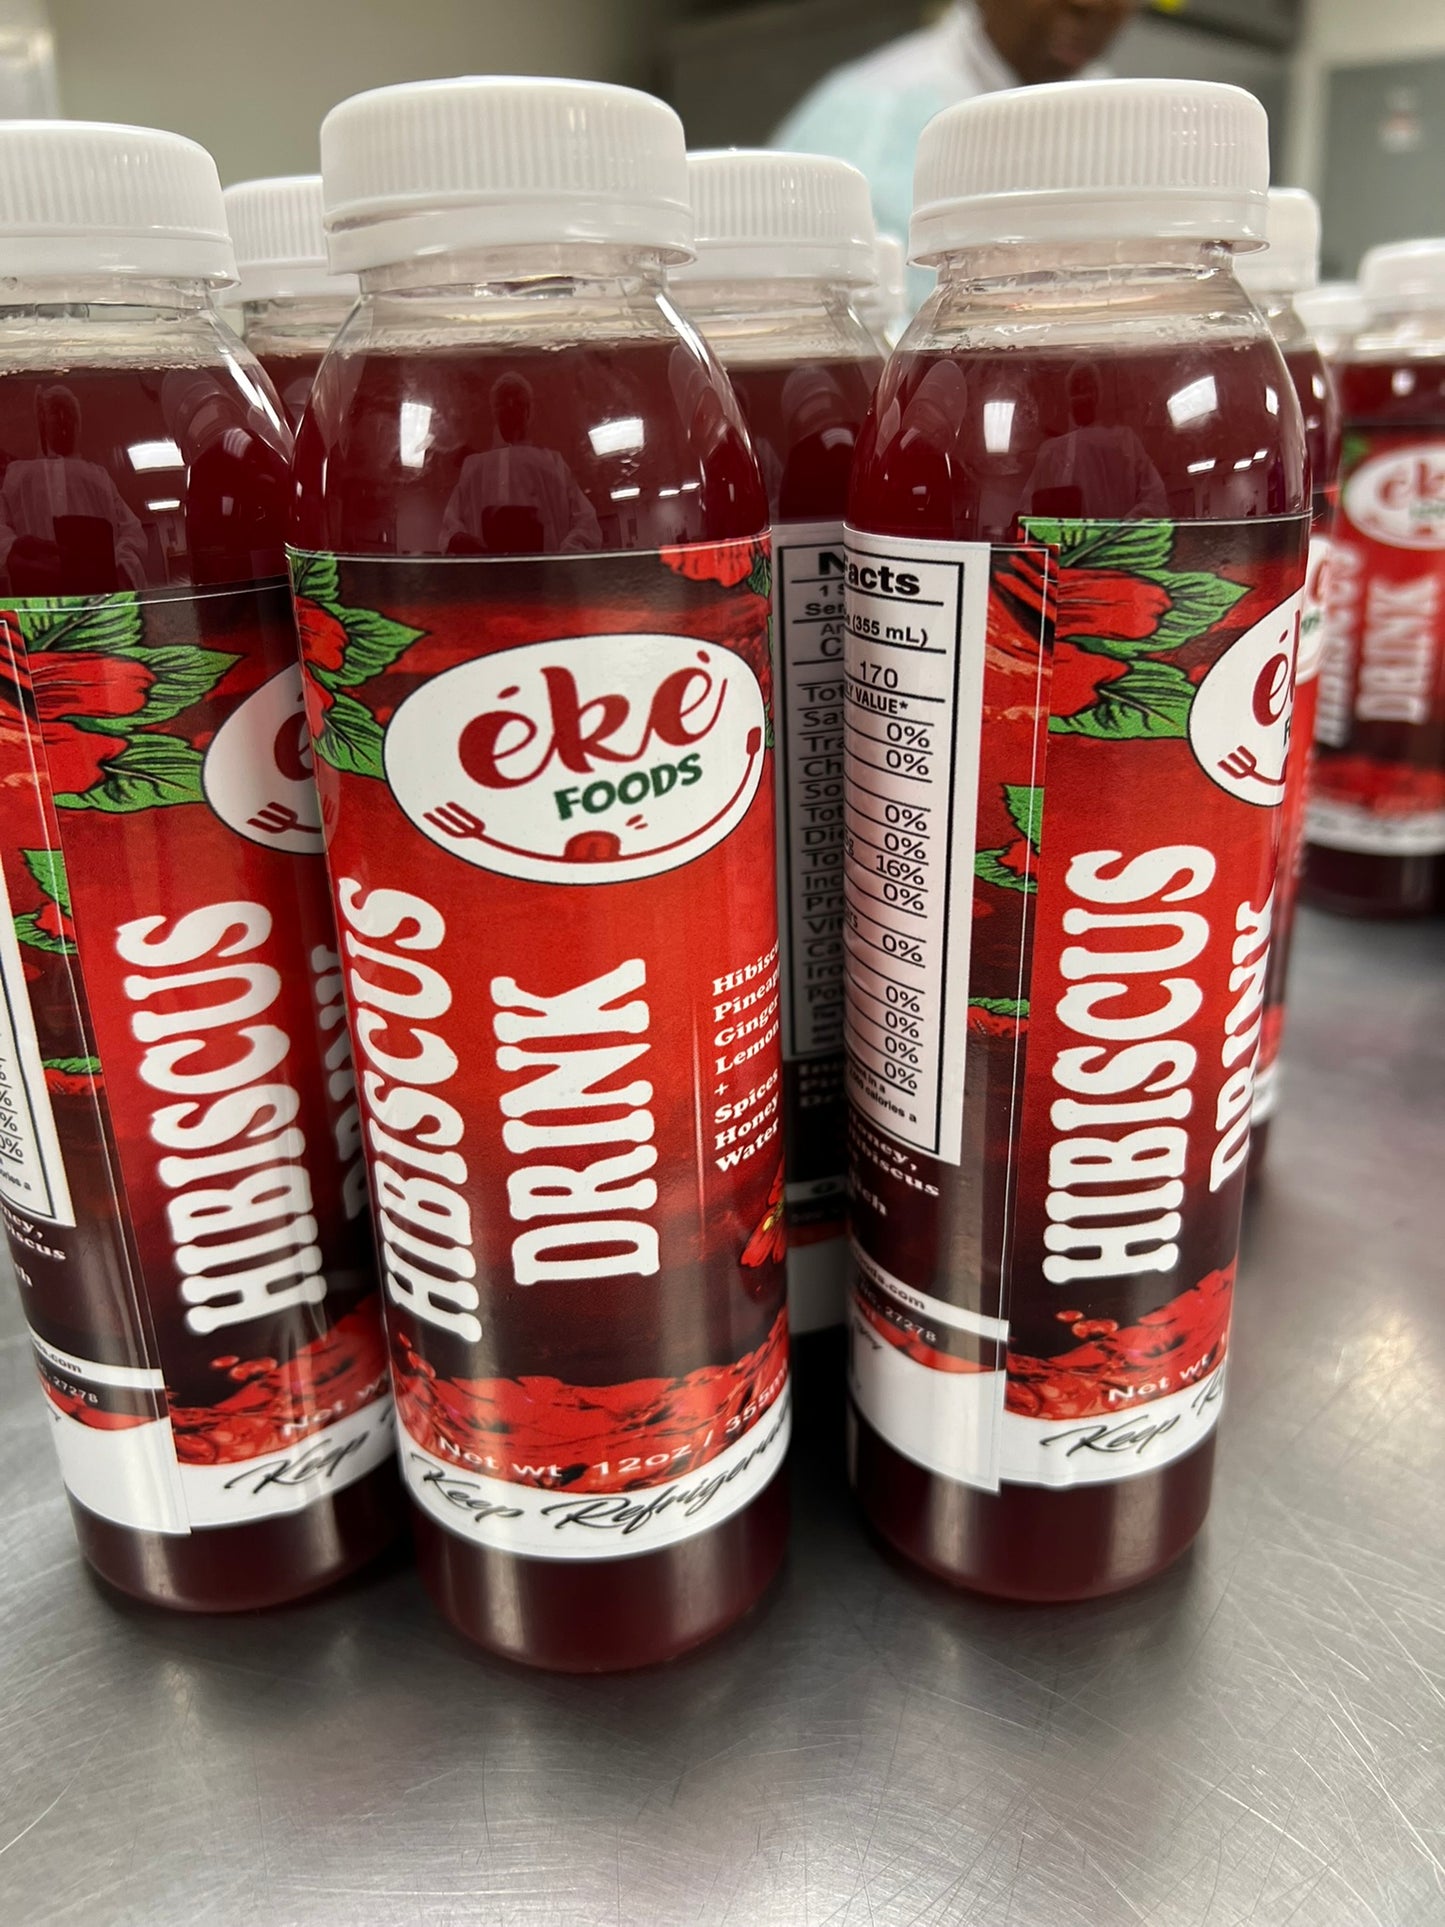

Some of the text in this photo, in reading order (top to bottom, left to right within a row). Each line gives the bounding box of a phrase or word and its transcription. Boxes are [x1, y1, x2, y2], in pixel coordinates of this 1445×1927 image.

[885, 626, 928, 648] mL)
[860, 660, 898, 689] 170
[886, 722, 930, 748] 0%
[886, 749, 929, 775] 0%
[554, 753, 703, 820] FOODS
[885, 804, 927, 831] 0%
[884, 832, 926, 860] 0%
[876, 854, 924, 885] 16%
[883, 883, 924, 911] 0%
[882, 934, 922, 963] 0%
[886, 985, 920, 1013] 0%
[714, 994, 778, 1047] Ginger
[885, 1011, 919, 1039] 0%
[1209, 880, 1276, 1193] DRINK
[715, 1019, 779, 1075] Lemon
[885, 1036, 919, 1064] 0%
[1042, 845, 1216, 1284] HIBISCUS
[714, 1082, 729, 1096] +
[884, 1061, 918, 1090] 0%
[338, 877, 482, 1343] HIBISCUS
[714, 1068, 778, 1124] Spices
[865, 1086, 906, 1118] calories
[908, 1113, 917, 1124] a
[115, 901, 328, 1335] HIBISCUS
[490, 958, 660, 1286] DRINK
[714, 1091, 779, 1150] Honey
[715, 1117, 779, 1172] Water
[884, 1305, 937, 1343] 27278
[53, 1376, 98, 1404] 27278
[1039, 1415, 1181, 1457] Keep
[223, 1431, 371, 1493] Keep
[592, 1444, 692, 1476] 12oz
[411, 1453, 525, 1523] Keep
